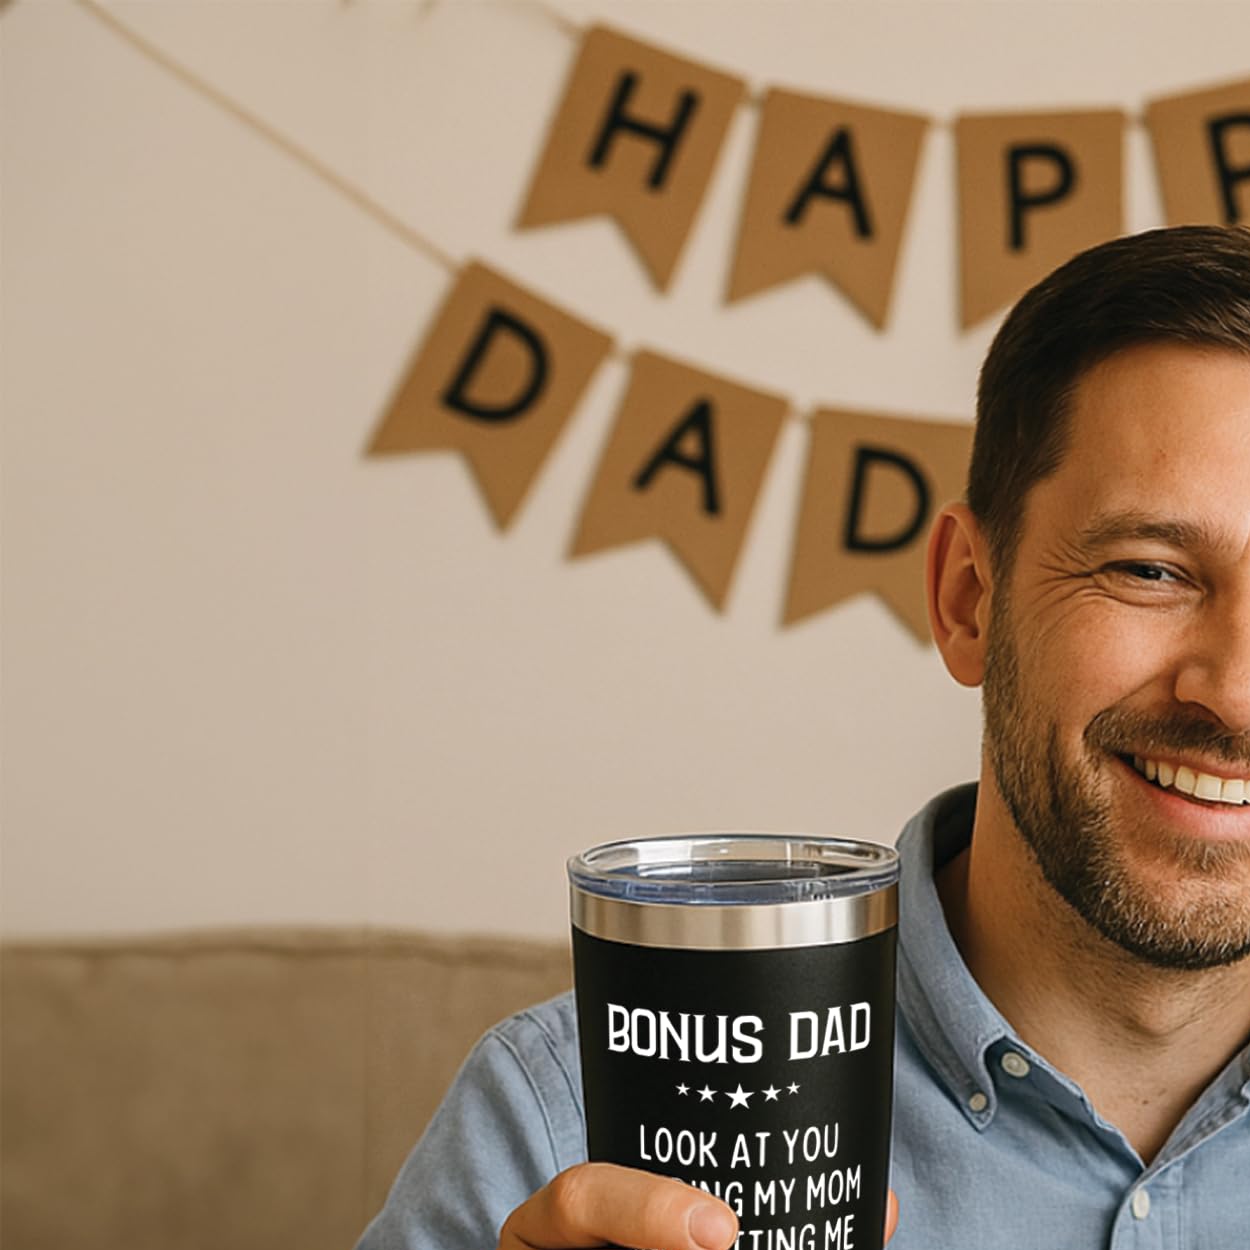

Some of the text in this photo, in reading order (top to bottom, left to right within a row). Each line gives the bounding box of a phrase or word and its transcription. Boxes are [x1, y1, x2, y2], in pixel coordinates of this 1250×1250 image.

[607, 1001, 871, 1064] BONUS DAD
[640, 1122, 839, 1169] LOOK AT YOU
[754, 1177, 796, 1217] MY
[806, 1164, 861, 1211] MOM
